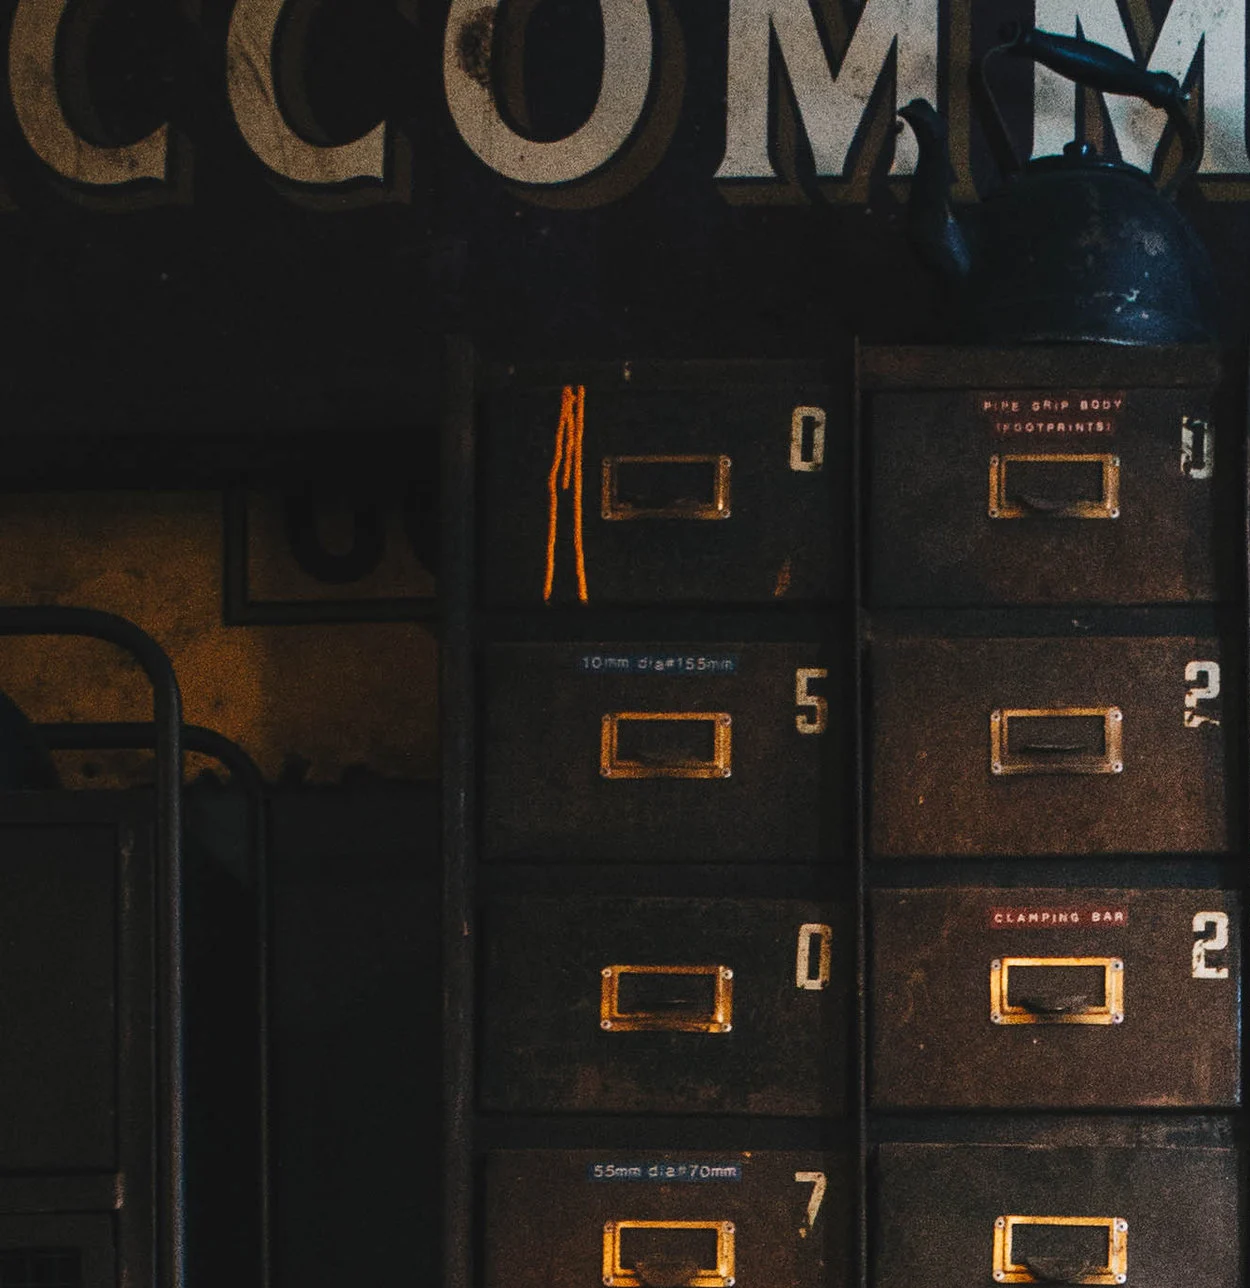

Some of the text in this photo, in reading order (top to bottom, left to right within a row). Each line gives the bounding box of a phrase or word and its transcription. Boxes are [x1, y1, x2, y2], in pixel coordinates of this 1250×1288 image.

[1079, 400, 1122, 411] BODY
[790, 406, 825, 471] 0
[582, 656, 630, 670] 10mm
[1184, 661, 1219, 727] 2
[796, 669, 825, 733] 5
[993, 911, 1124, 923] CLAMPING BAR
[1192, 912, 1228, 978] 2
[797, 924, 830, 989] 0
[593, 1164, 641, 1179] 55mm
[795, 1172, 826, 1237] 7
